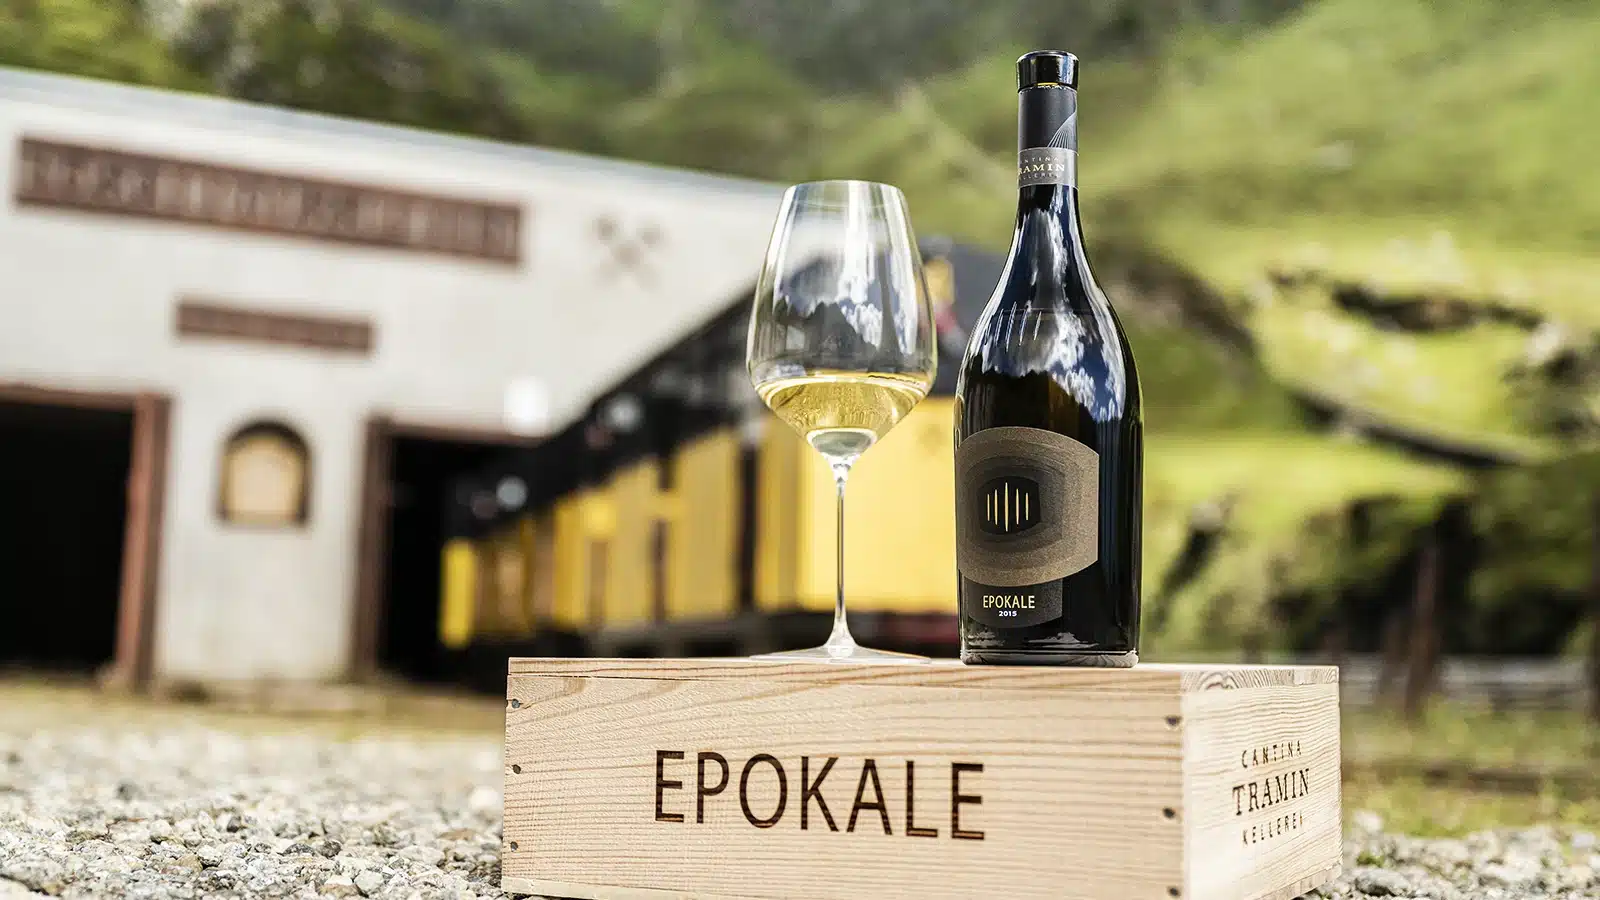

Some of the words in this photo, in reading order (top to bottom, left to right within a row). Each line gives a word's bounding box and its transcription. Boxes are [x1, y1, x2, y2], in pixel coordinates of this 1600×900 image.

[1018, 163, 1065, 175] RAMIN
[983, 595, 1035, 609] EPOKALE
[1241, 740, 1302, 769] CANTINA
[655, 750, 985, 840] EPOKALE
[1232, 768, 1310, 816] TRAMIN
[1242, 811, 1303, 845] KELLEREI
